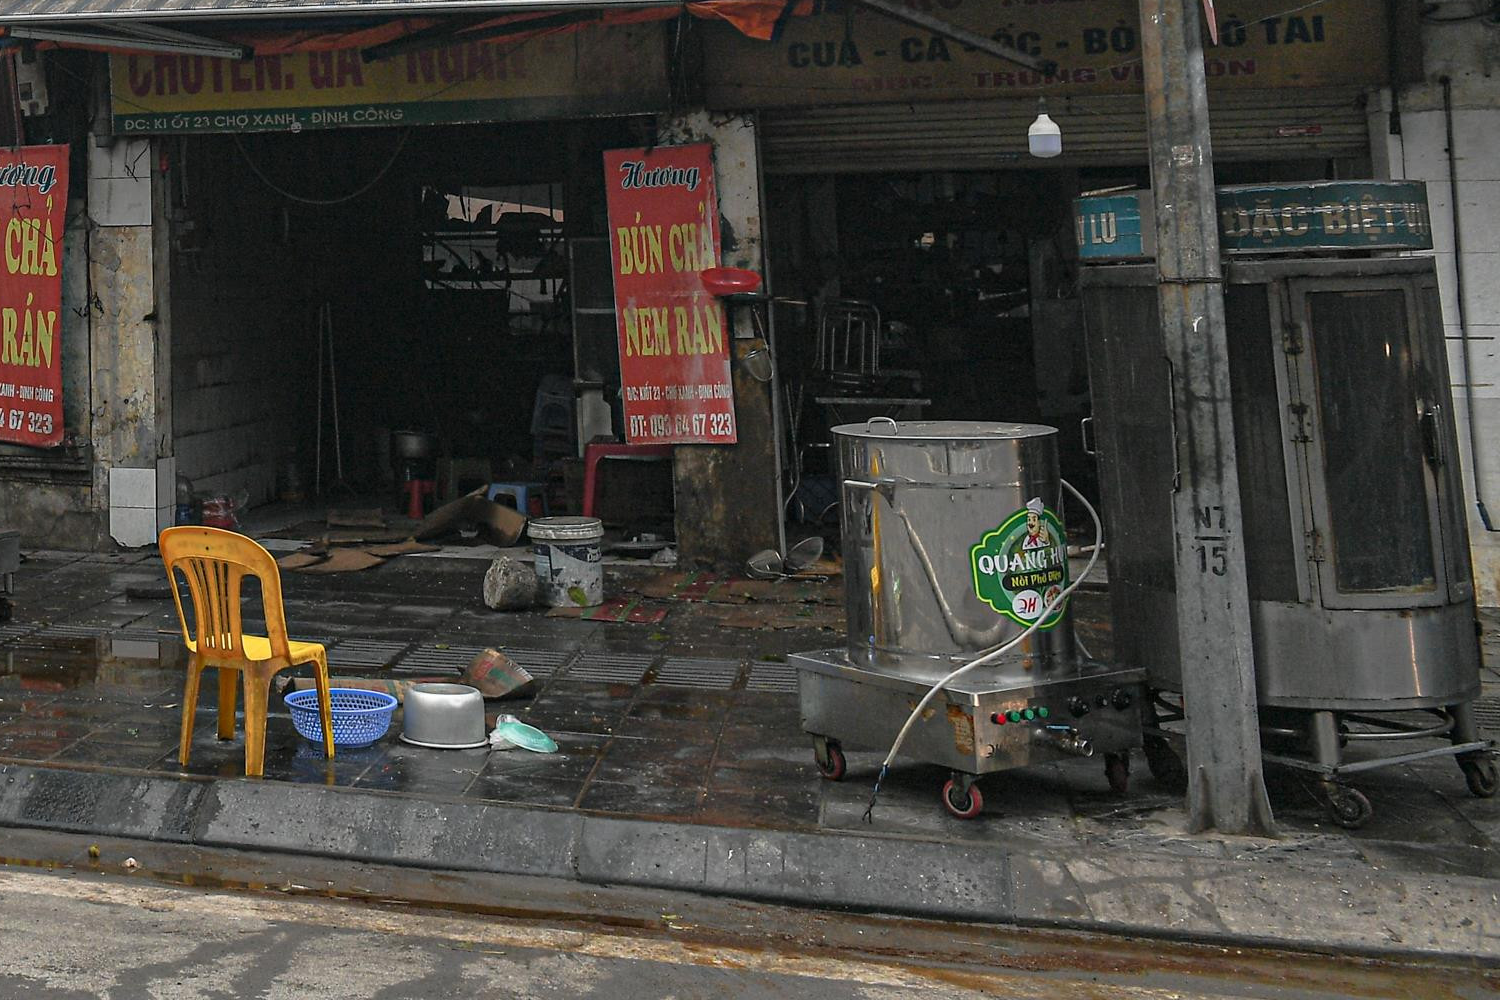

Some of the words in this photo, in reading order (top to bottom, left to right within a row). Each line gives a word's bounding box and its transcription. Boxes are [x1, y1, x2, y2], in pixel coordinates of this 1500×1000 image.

[1260, 14, 1325, 45] TAI
[214, 113, 249, 129] CHỢ
[252, 113, 297, 127] XANH
[311, 111, 349, 126] ĐỊNH
[353, 109, 404, 122] CÔNG
[619, 160, 700, 190] Hương
[5, 194, 58, 277] CHẢ
[617, 212, 664, 276] BÚN
[668, 201, 717, 274] CHẢ
[2, 292, 56, 369] RÁN
[623, 305, 671, 357] NEM
[674, 299, 723, 356] RÁN
[9, 409, 25, 430] 67
[28, 411, 53, 435] 323
[693, 413, 706, 436] 67
[710, 413, 733, 436] 323
[978, 550, 1047, 576] QUANG
[1194, 545, 1228, 577] 15
